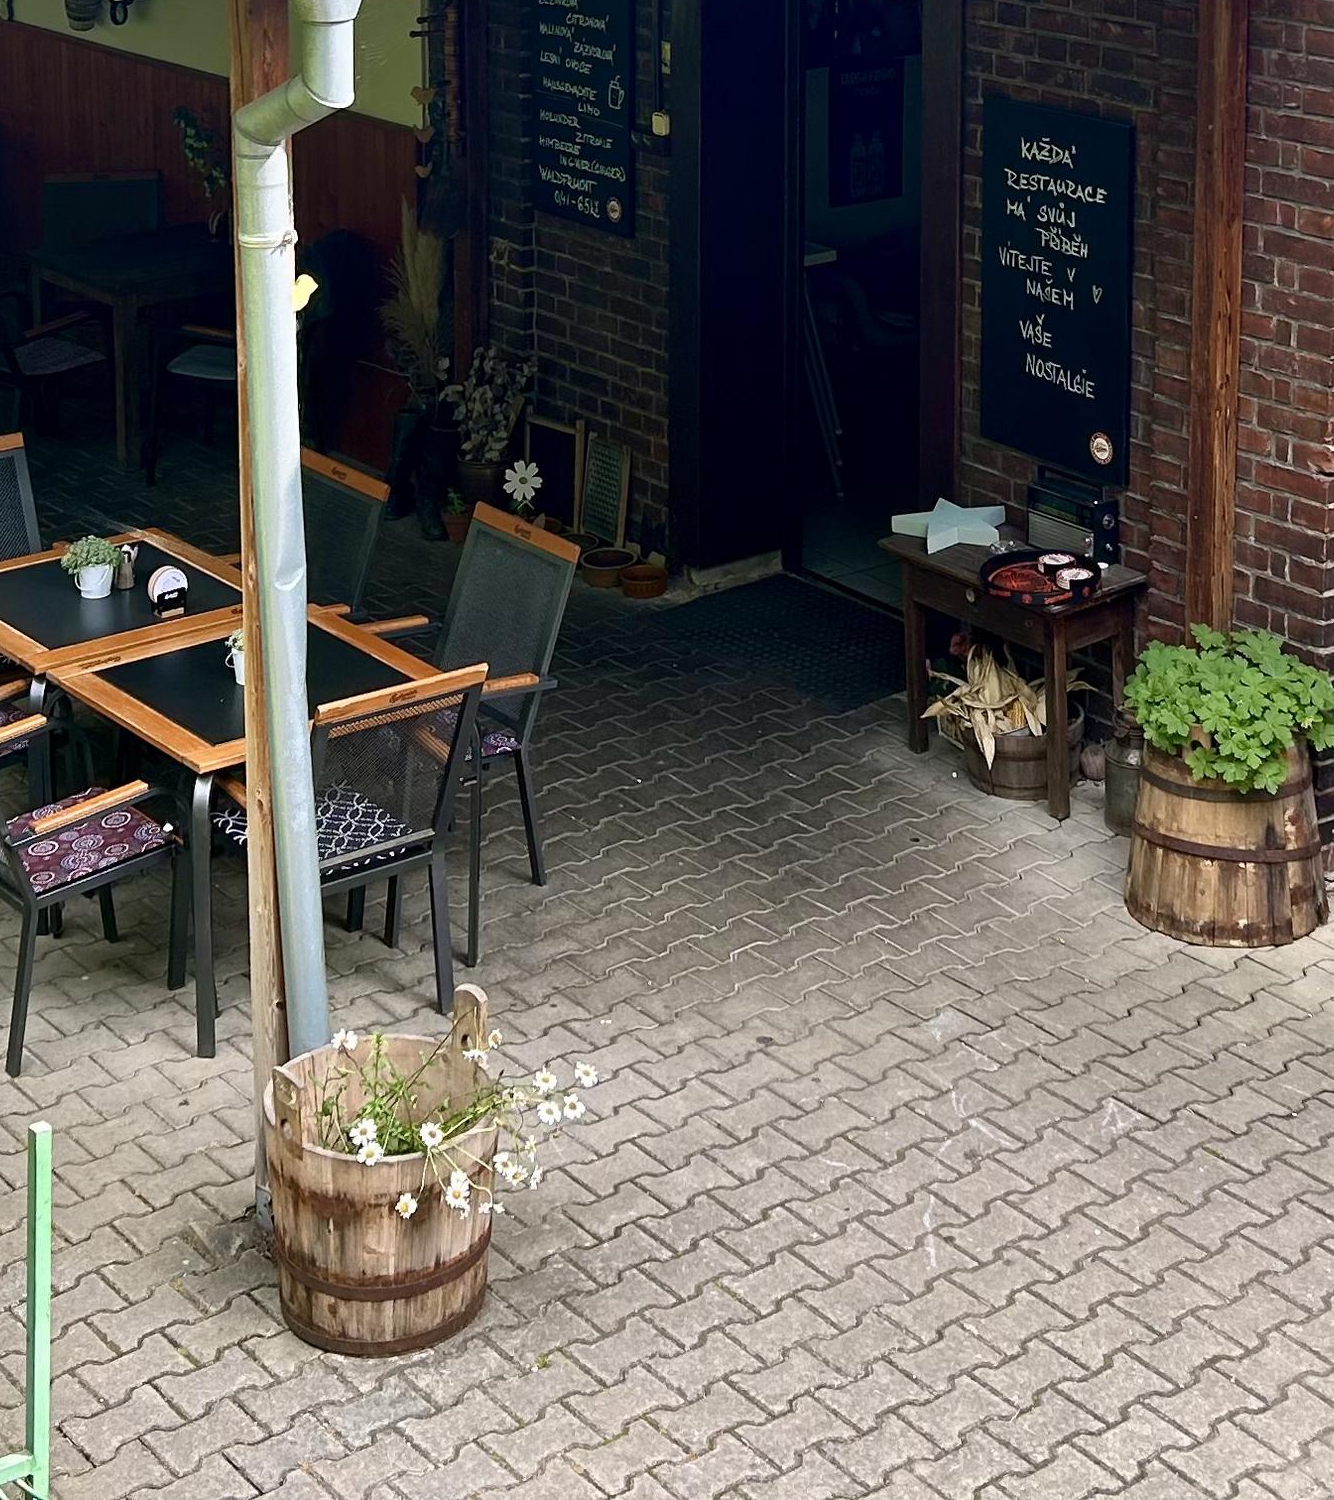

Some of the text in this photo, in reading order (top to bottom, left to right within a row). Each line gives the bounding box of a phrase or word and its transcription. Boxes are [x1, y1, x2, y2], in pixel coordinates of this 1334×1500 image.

[1020, 136, 1077, 170] KAŽDÁ
[1004, 167, 1108, 204] RESTAURACE
[1006, 195, 1076, 228] MÁ SVŮJ
[1034, 225, 1089, 259] PŘÍBĚH
[998, 240, 1077, 283] VÍTEJTE V
[1026, 277, 1075, 311] NAŠEM
[1018, 313, 1053, 349] VAŠE
[1025, 352, 1096, 400] NOSTALGIE
